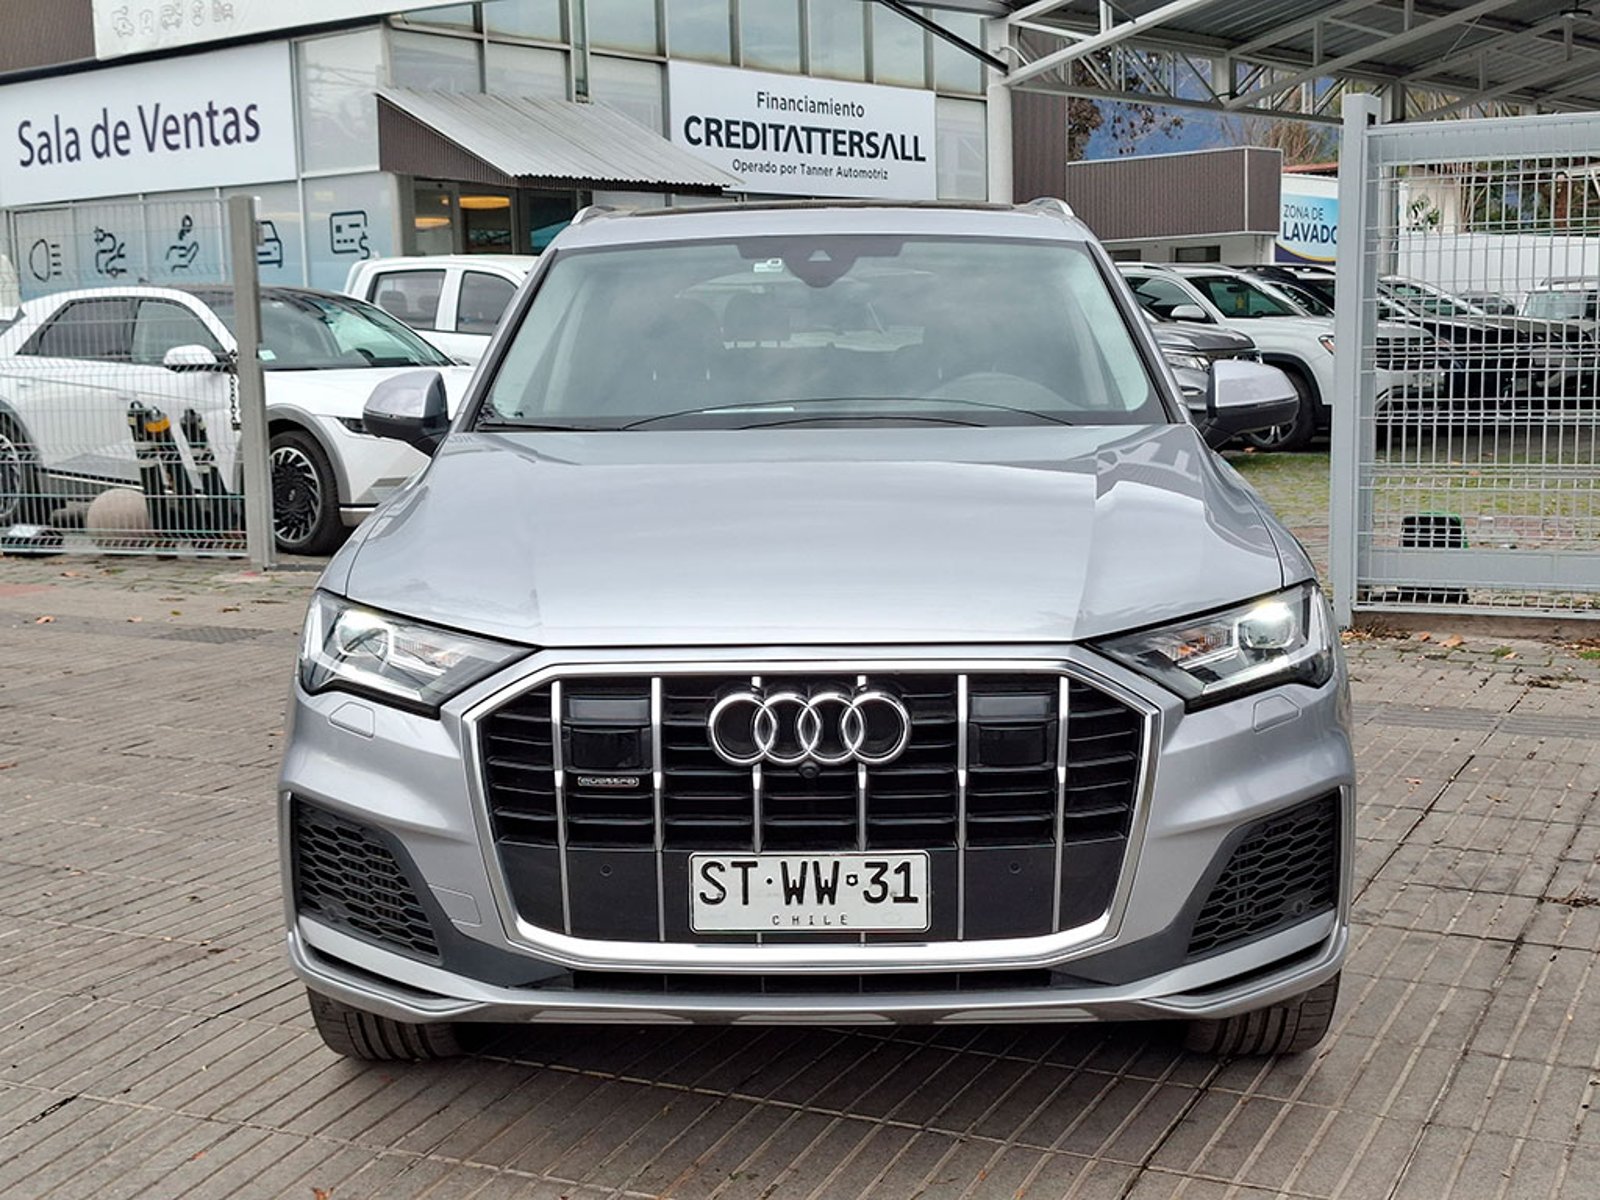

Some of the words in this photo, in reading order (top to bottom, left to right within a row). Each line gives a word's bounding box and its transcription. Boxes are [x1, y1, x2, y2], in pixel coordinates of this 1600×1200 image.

[757, 91, 865, 118] Financiamiento
[18, 114, 81, 167] Sala
[90, 108, 131, 158] de
[138, 100, 260, 153] Ventas
[684, 115, 926, 162] CREDITATTERSALL
[732, 158, 777, 175] Operado
[780, 163, 797, 176] por
[800, 163, 833, 177] Tanner
[836, 165, 888, 180] Automotriz
[1283, 204, 1309, 220] ZONA
[1311, 207, 1324, 221] DE
[772, 915, 848, 926] CHILE
